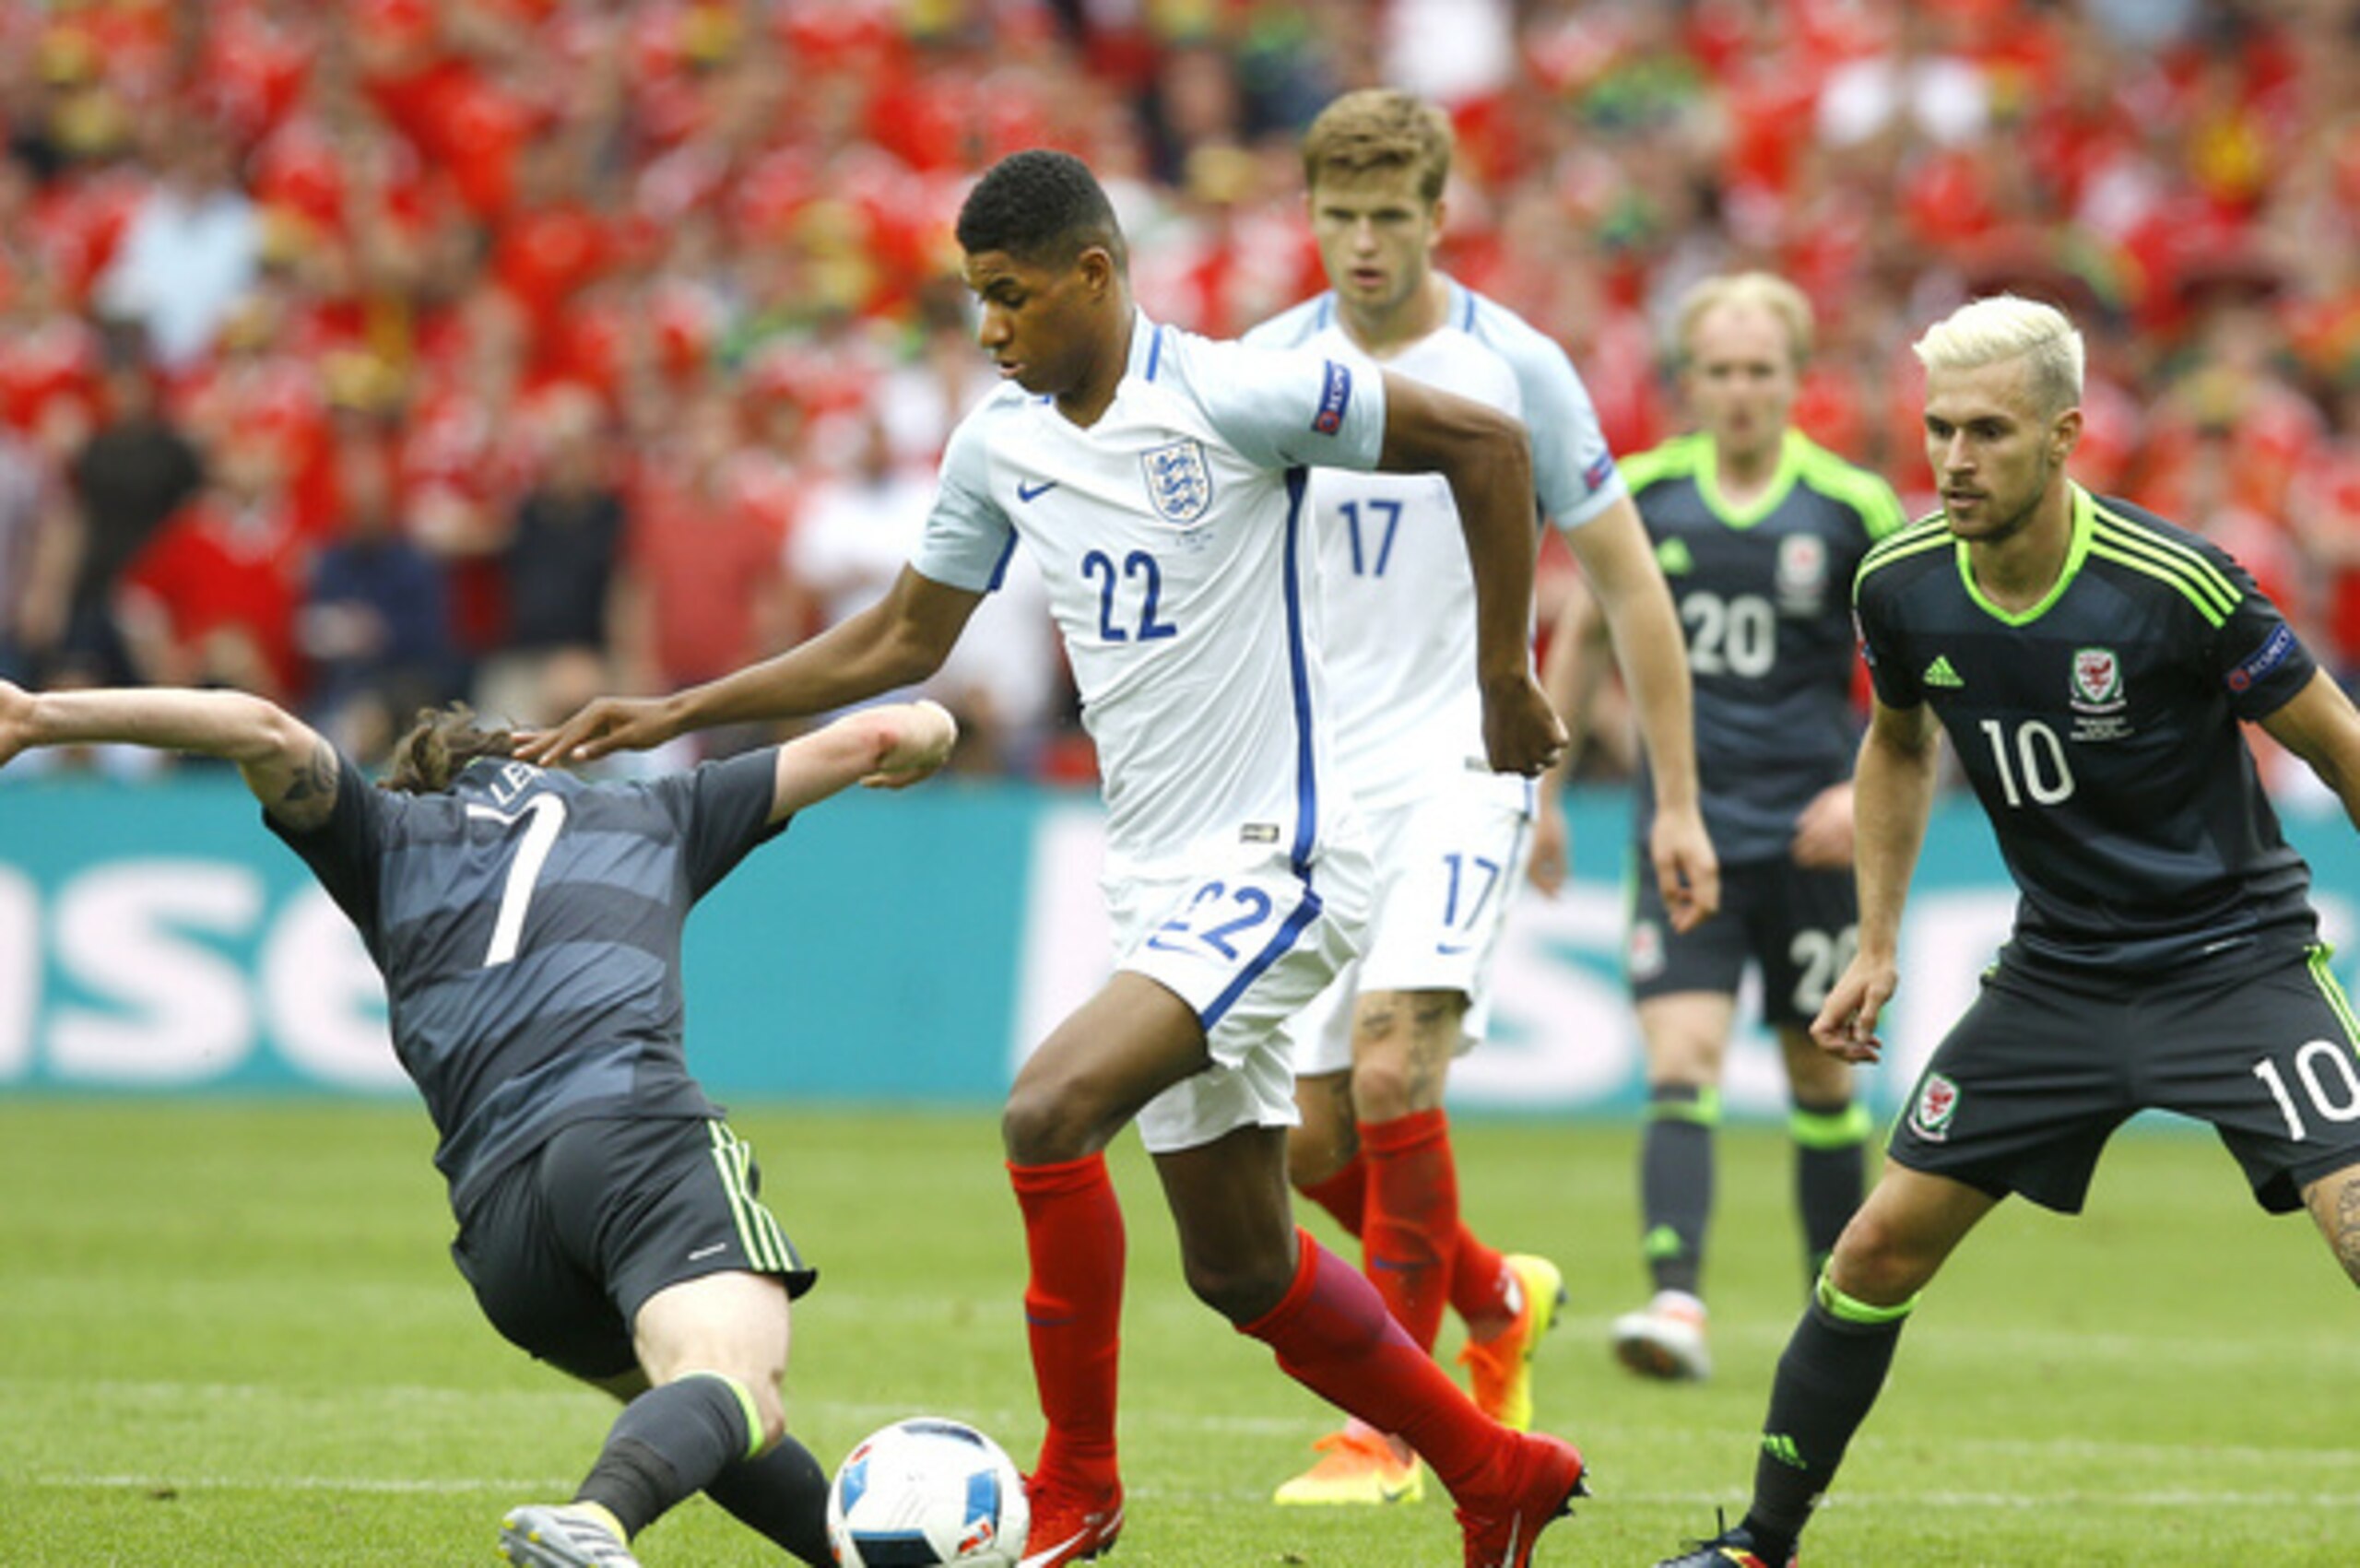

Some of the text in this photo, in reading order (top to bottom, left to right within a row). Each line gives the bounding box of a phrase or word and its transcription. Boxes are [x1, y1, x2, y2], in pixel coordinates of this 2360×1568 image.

[1340, 500, 1401, 575] 17
[1081, 550, 1176, 641] 22
[1682, 593, 1774, 678] 20
[1980, 720, 2075, 808] 10
[466, 791, 567, 967] 7
[1444, 854, 1500, 930] 17
[1789, 925, 1858, 1016] 2
[2253, 1039, 2360, 1141] 10
